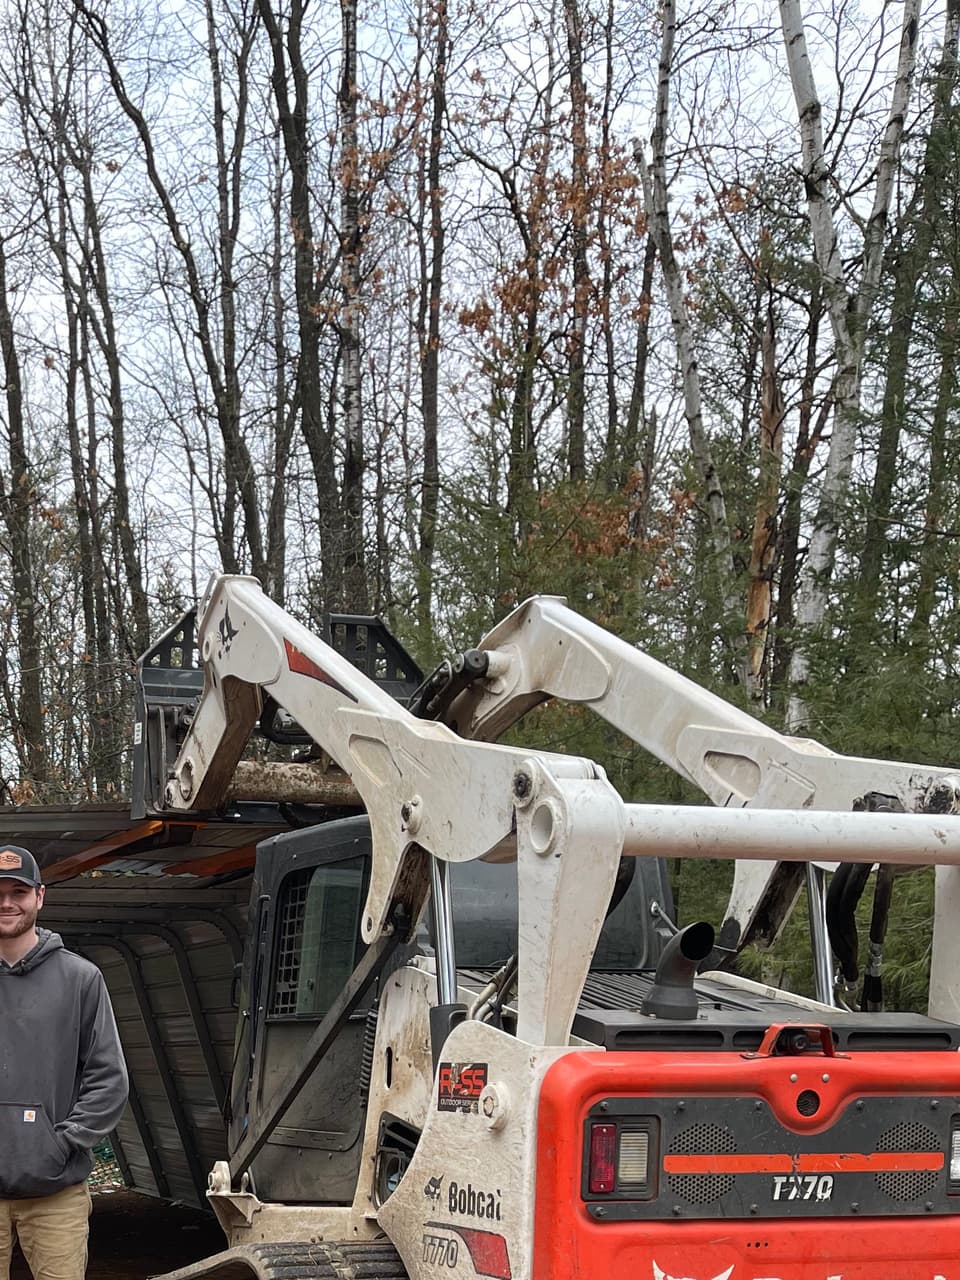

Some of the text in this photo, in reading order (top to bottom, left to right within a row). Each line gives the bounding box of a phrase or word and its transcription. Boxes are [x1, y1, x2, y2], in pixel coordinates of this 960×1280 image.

[448, 1181, 502, 1221] Bobcat
[772, 1174, 835, 1202] T770
[422, 1233, 459, 1269] T770
